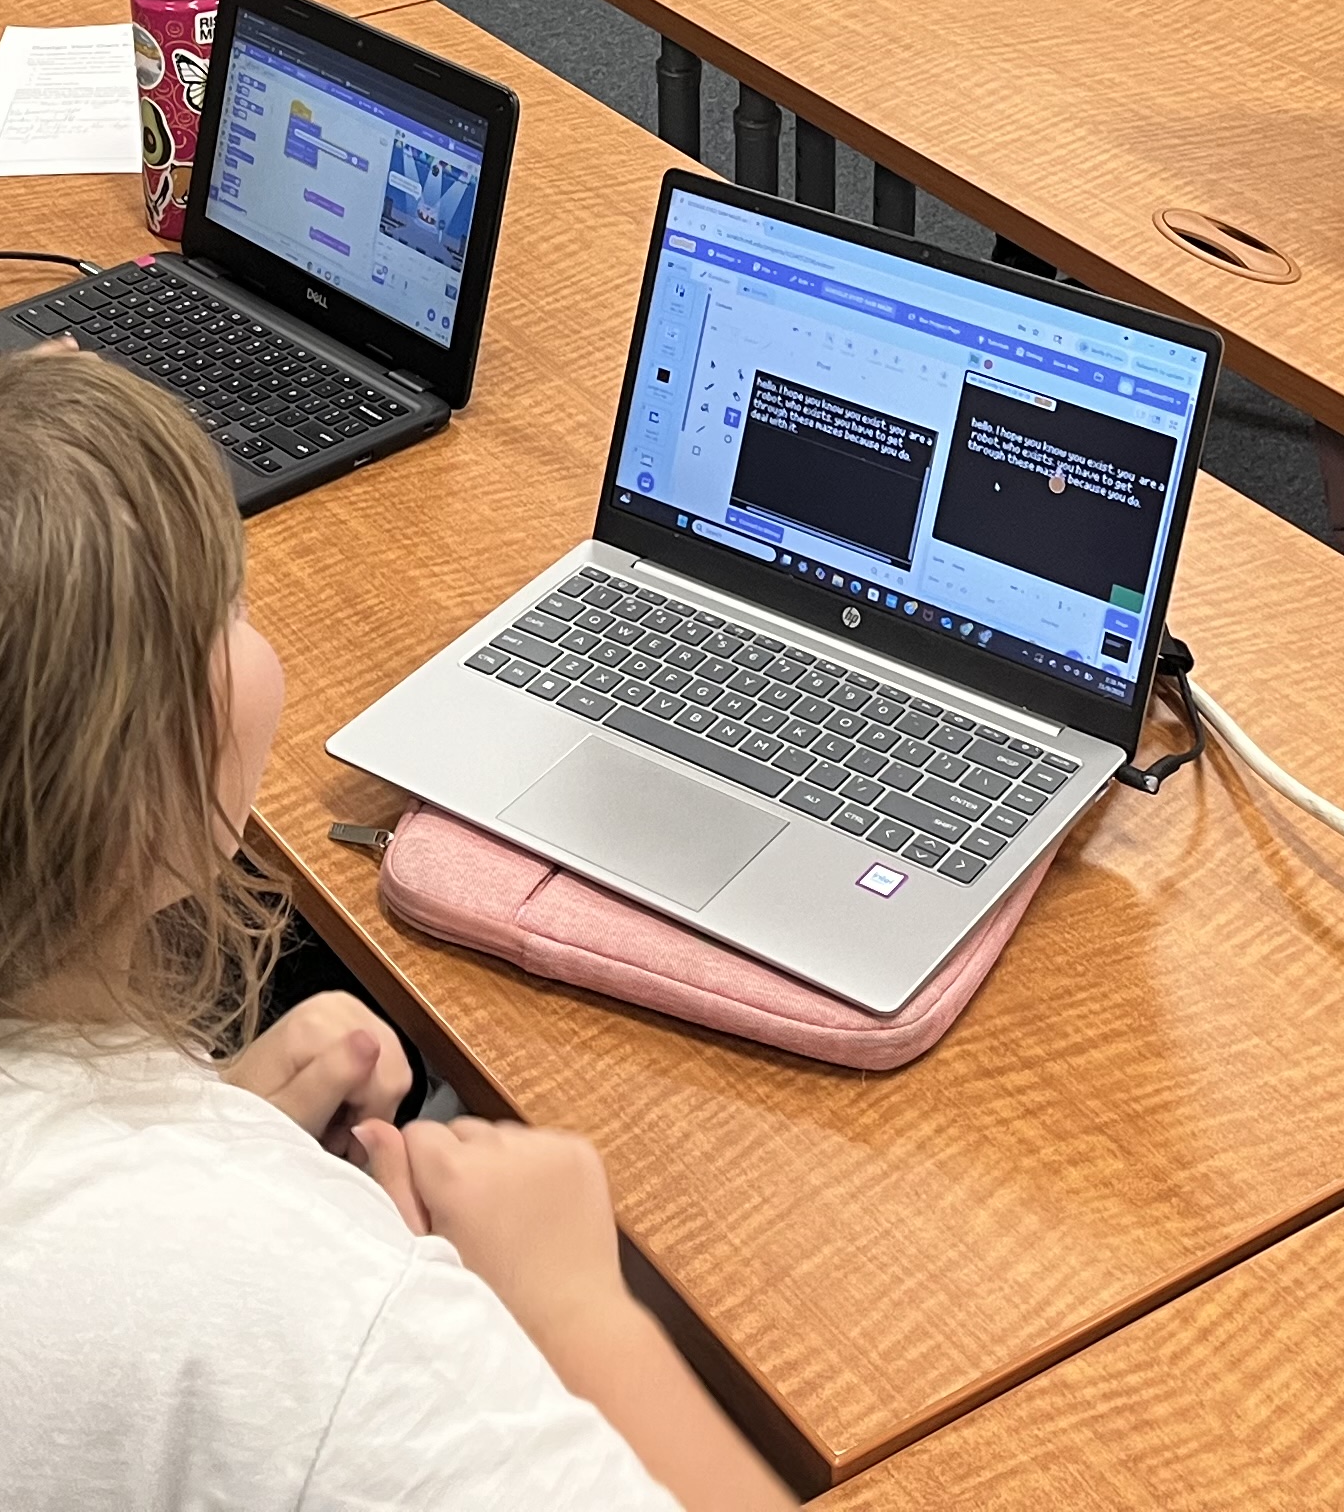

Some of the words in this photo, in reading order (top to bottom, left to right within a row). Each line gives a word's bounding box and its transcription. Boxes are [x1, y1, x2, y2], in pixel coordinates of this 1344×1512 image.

[306, 288, 328, 309] DELL
[843, 607, 860, 628] hp
[950, 795, 978, 809] ENTER
